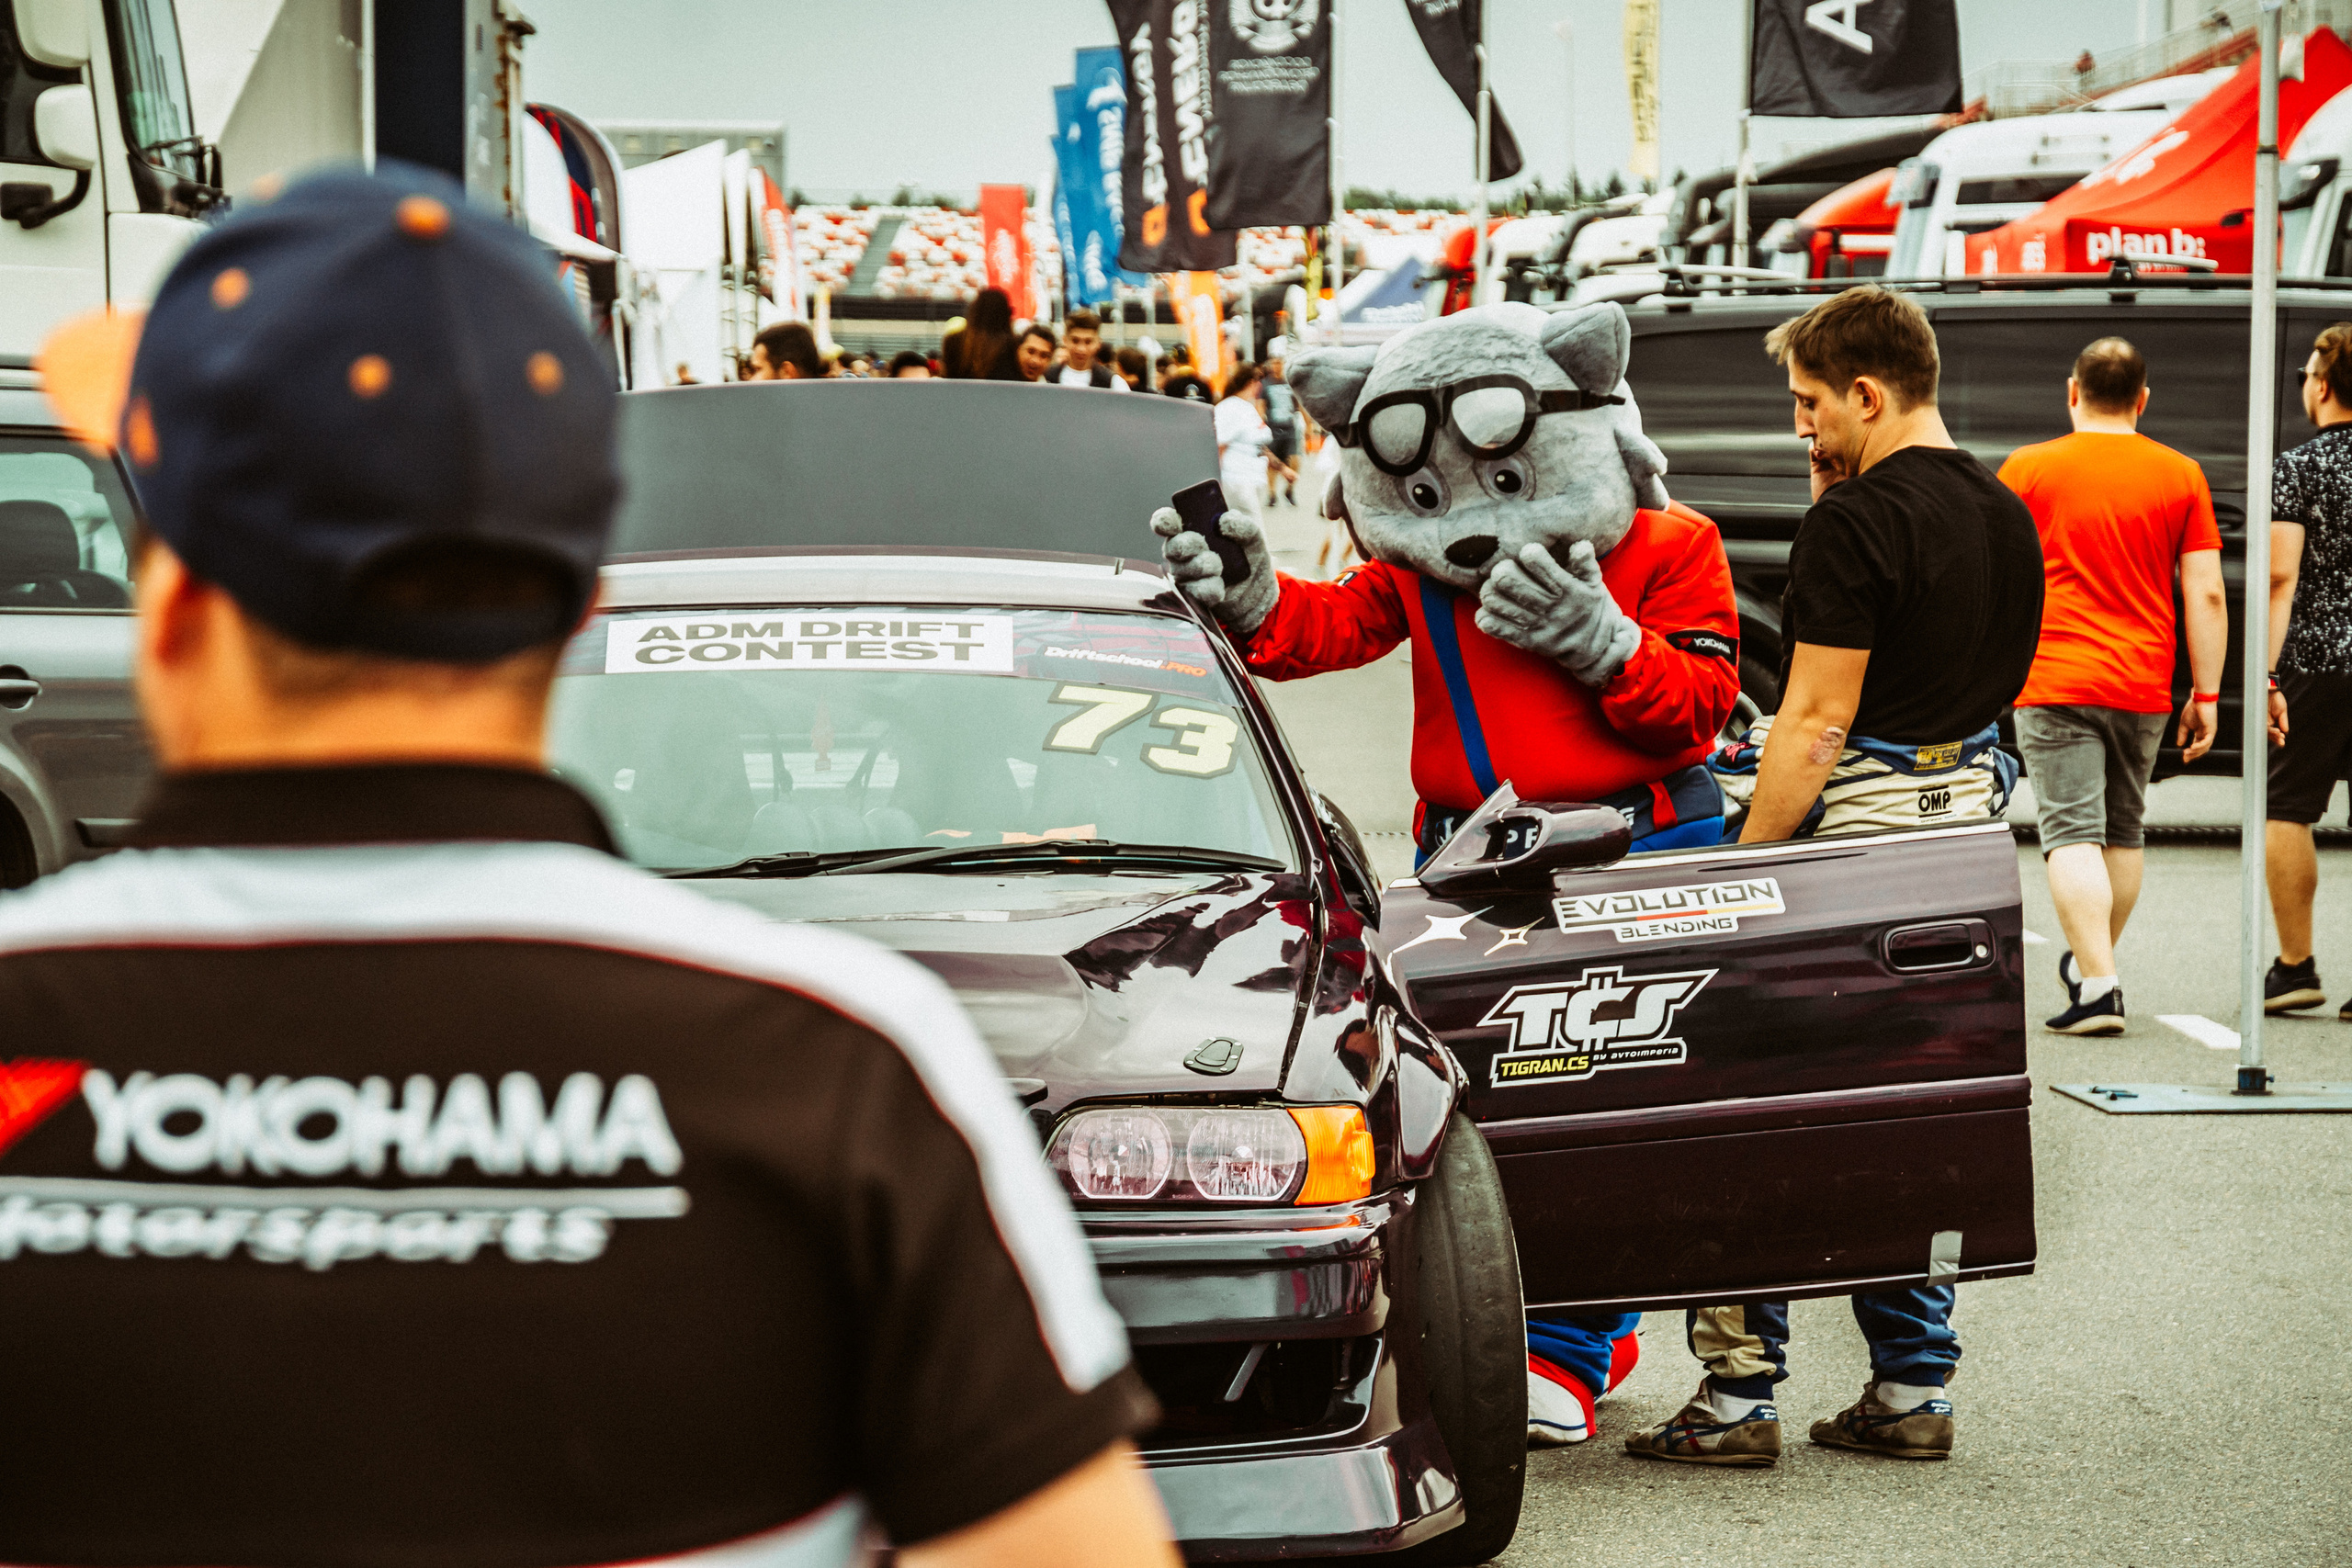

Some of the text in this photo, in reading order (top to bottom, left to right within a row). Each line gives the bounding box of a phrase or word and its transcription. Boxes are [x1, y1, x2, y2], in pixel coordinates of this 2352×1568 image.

[2086, 226, 2168, 266] plan
[636, 620, 985, 643] ADM DRIFT
[635, 642, 985, 664] CONTEST
[1693, 637, 1731, 654] YOKOHAMA
[1042, 682, 1240, 778] 73
[1918, 791, 1951, 812] OMP
[1560, 882, 1776, 918] EVOLUTION
[1621, 918, 1733, 938] BLENDING
[1501, 1055, 1589, 1077] TIGRAN.CS
[81, 1069, 684, 1178] YOKOHAMA
